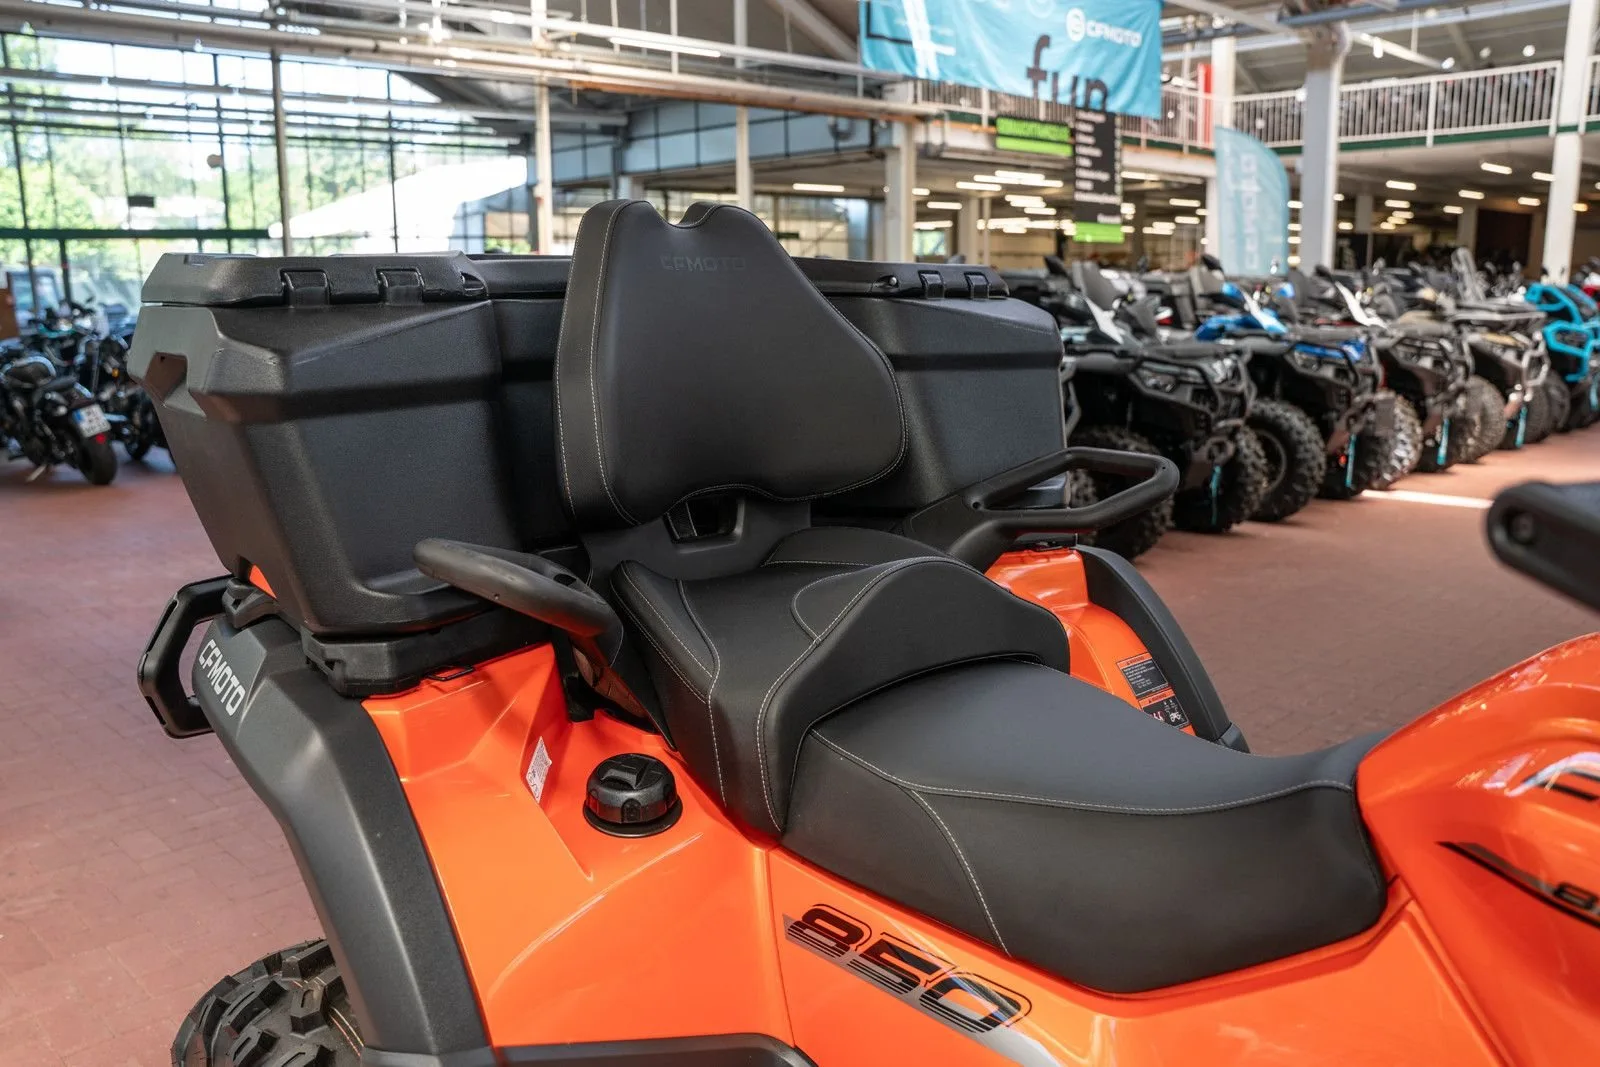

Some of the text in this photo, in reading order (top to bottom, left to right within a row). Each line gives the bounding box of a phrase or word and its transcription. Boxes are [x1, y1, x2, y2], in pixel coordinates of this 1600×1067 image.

[661, 255, 746, 272] CFMOTO
[198, 639, 246, 716] CFMOTO
[787, 904, 1032, 1033] 850
